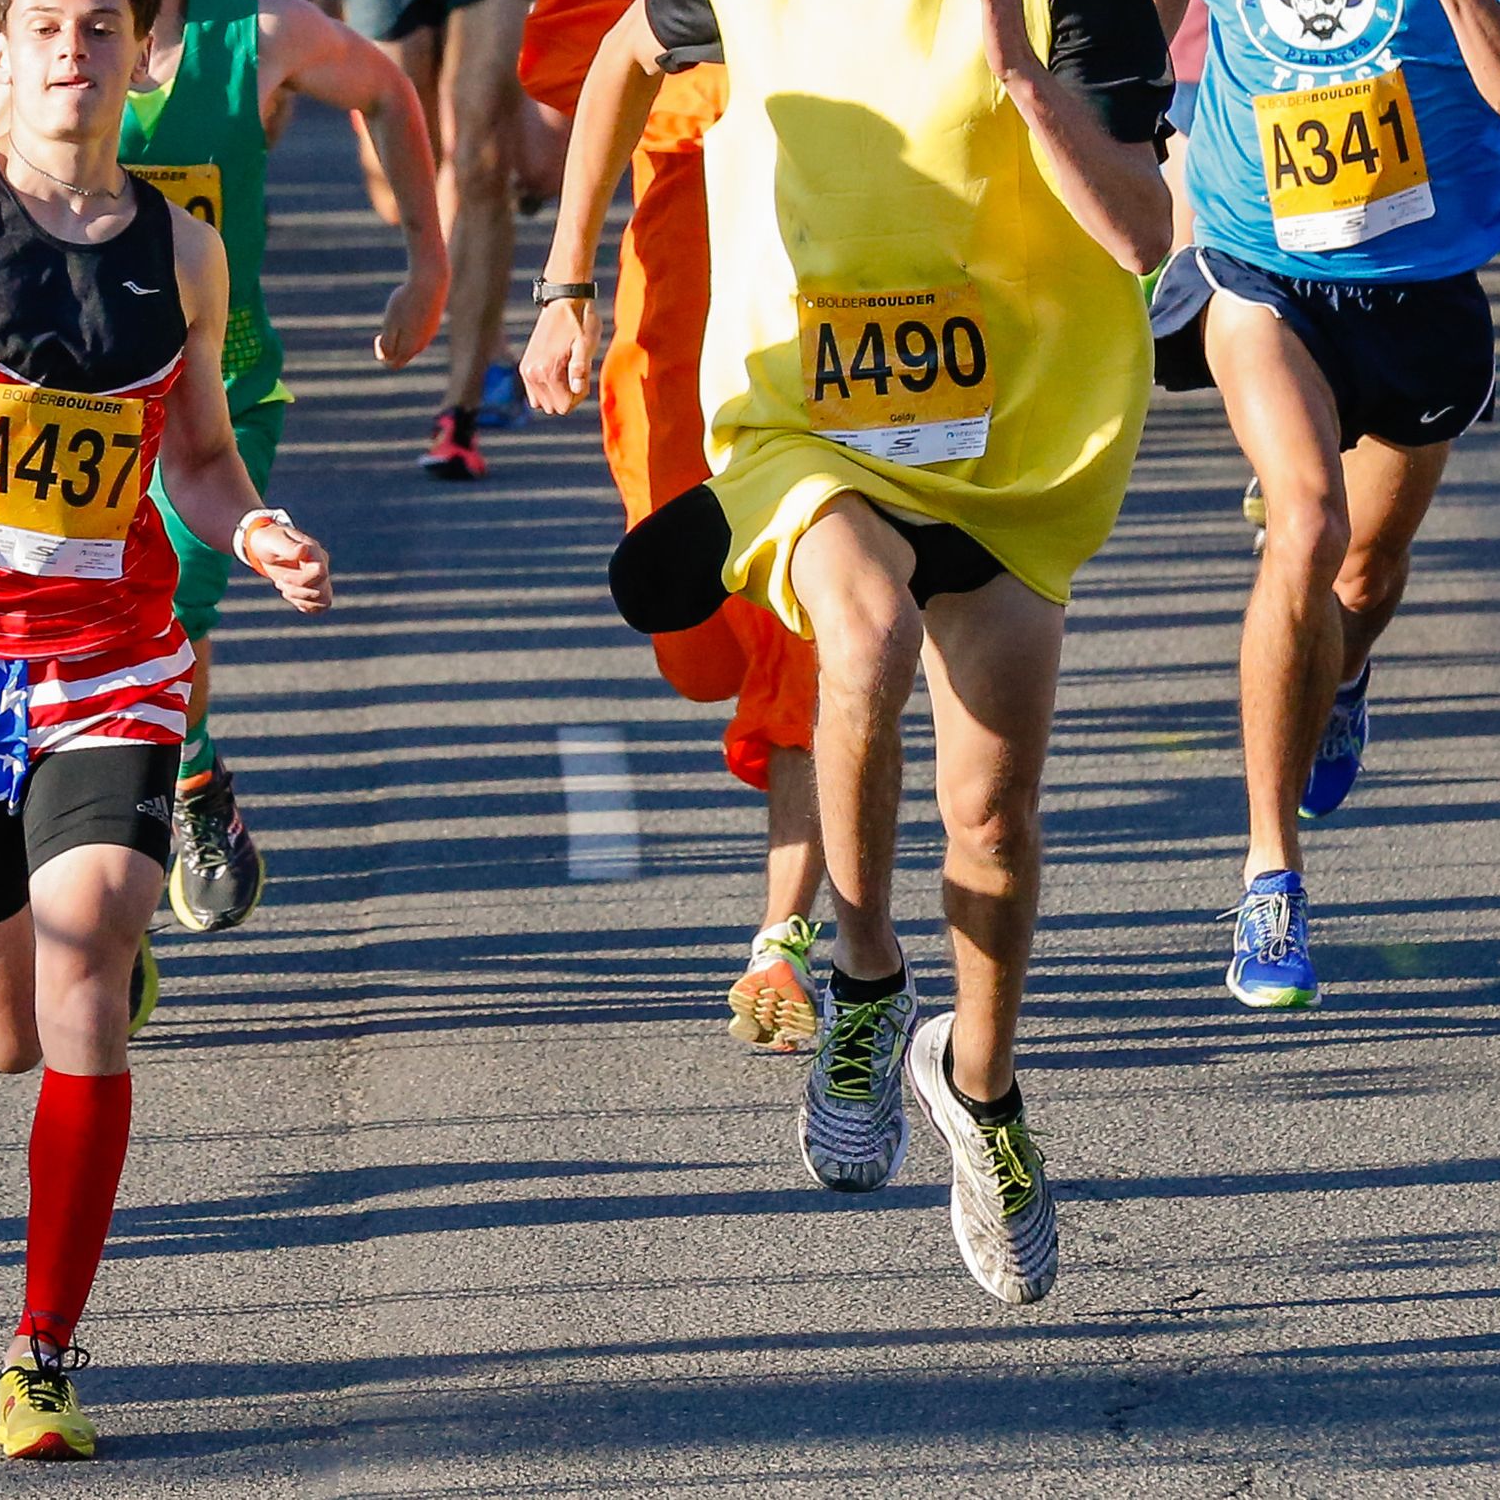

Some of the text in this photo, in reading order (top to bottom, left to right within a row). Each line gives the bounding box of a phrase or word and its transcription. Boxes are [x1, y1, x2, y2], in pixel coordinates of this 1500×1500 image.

[1284, 37, 1371, 65] PIRATES
[1268, 84, 1372, 109] BOLDERBOULDER
[1272, 98, 1410, 190] A341
[816, 293, 936, 309] BOLDERBOULDER
[813, 315, 987, 401] A490
[2, 389, 123, 415] BOLDERBOULDER
[889, 412, 916, 423] Goldy
